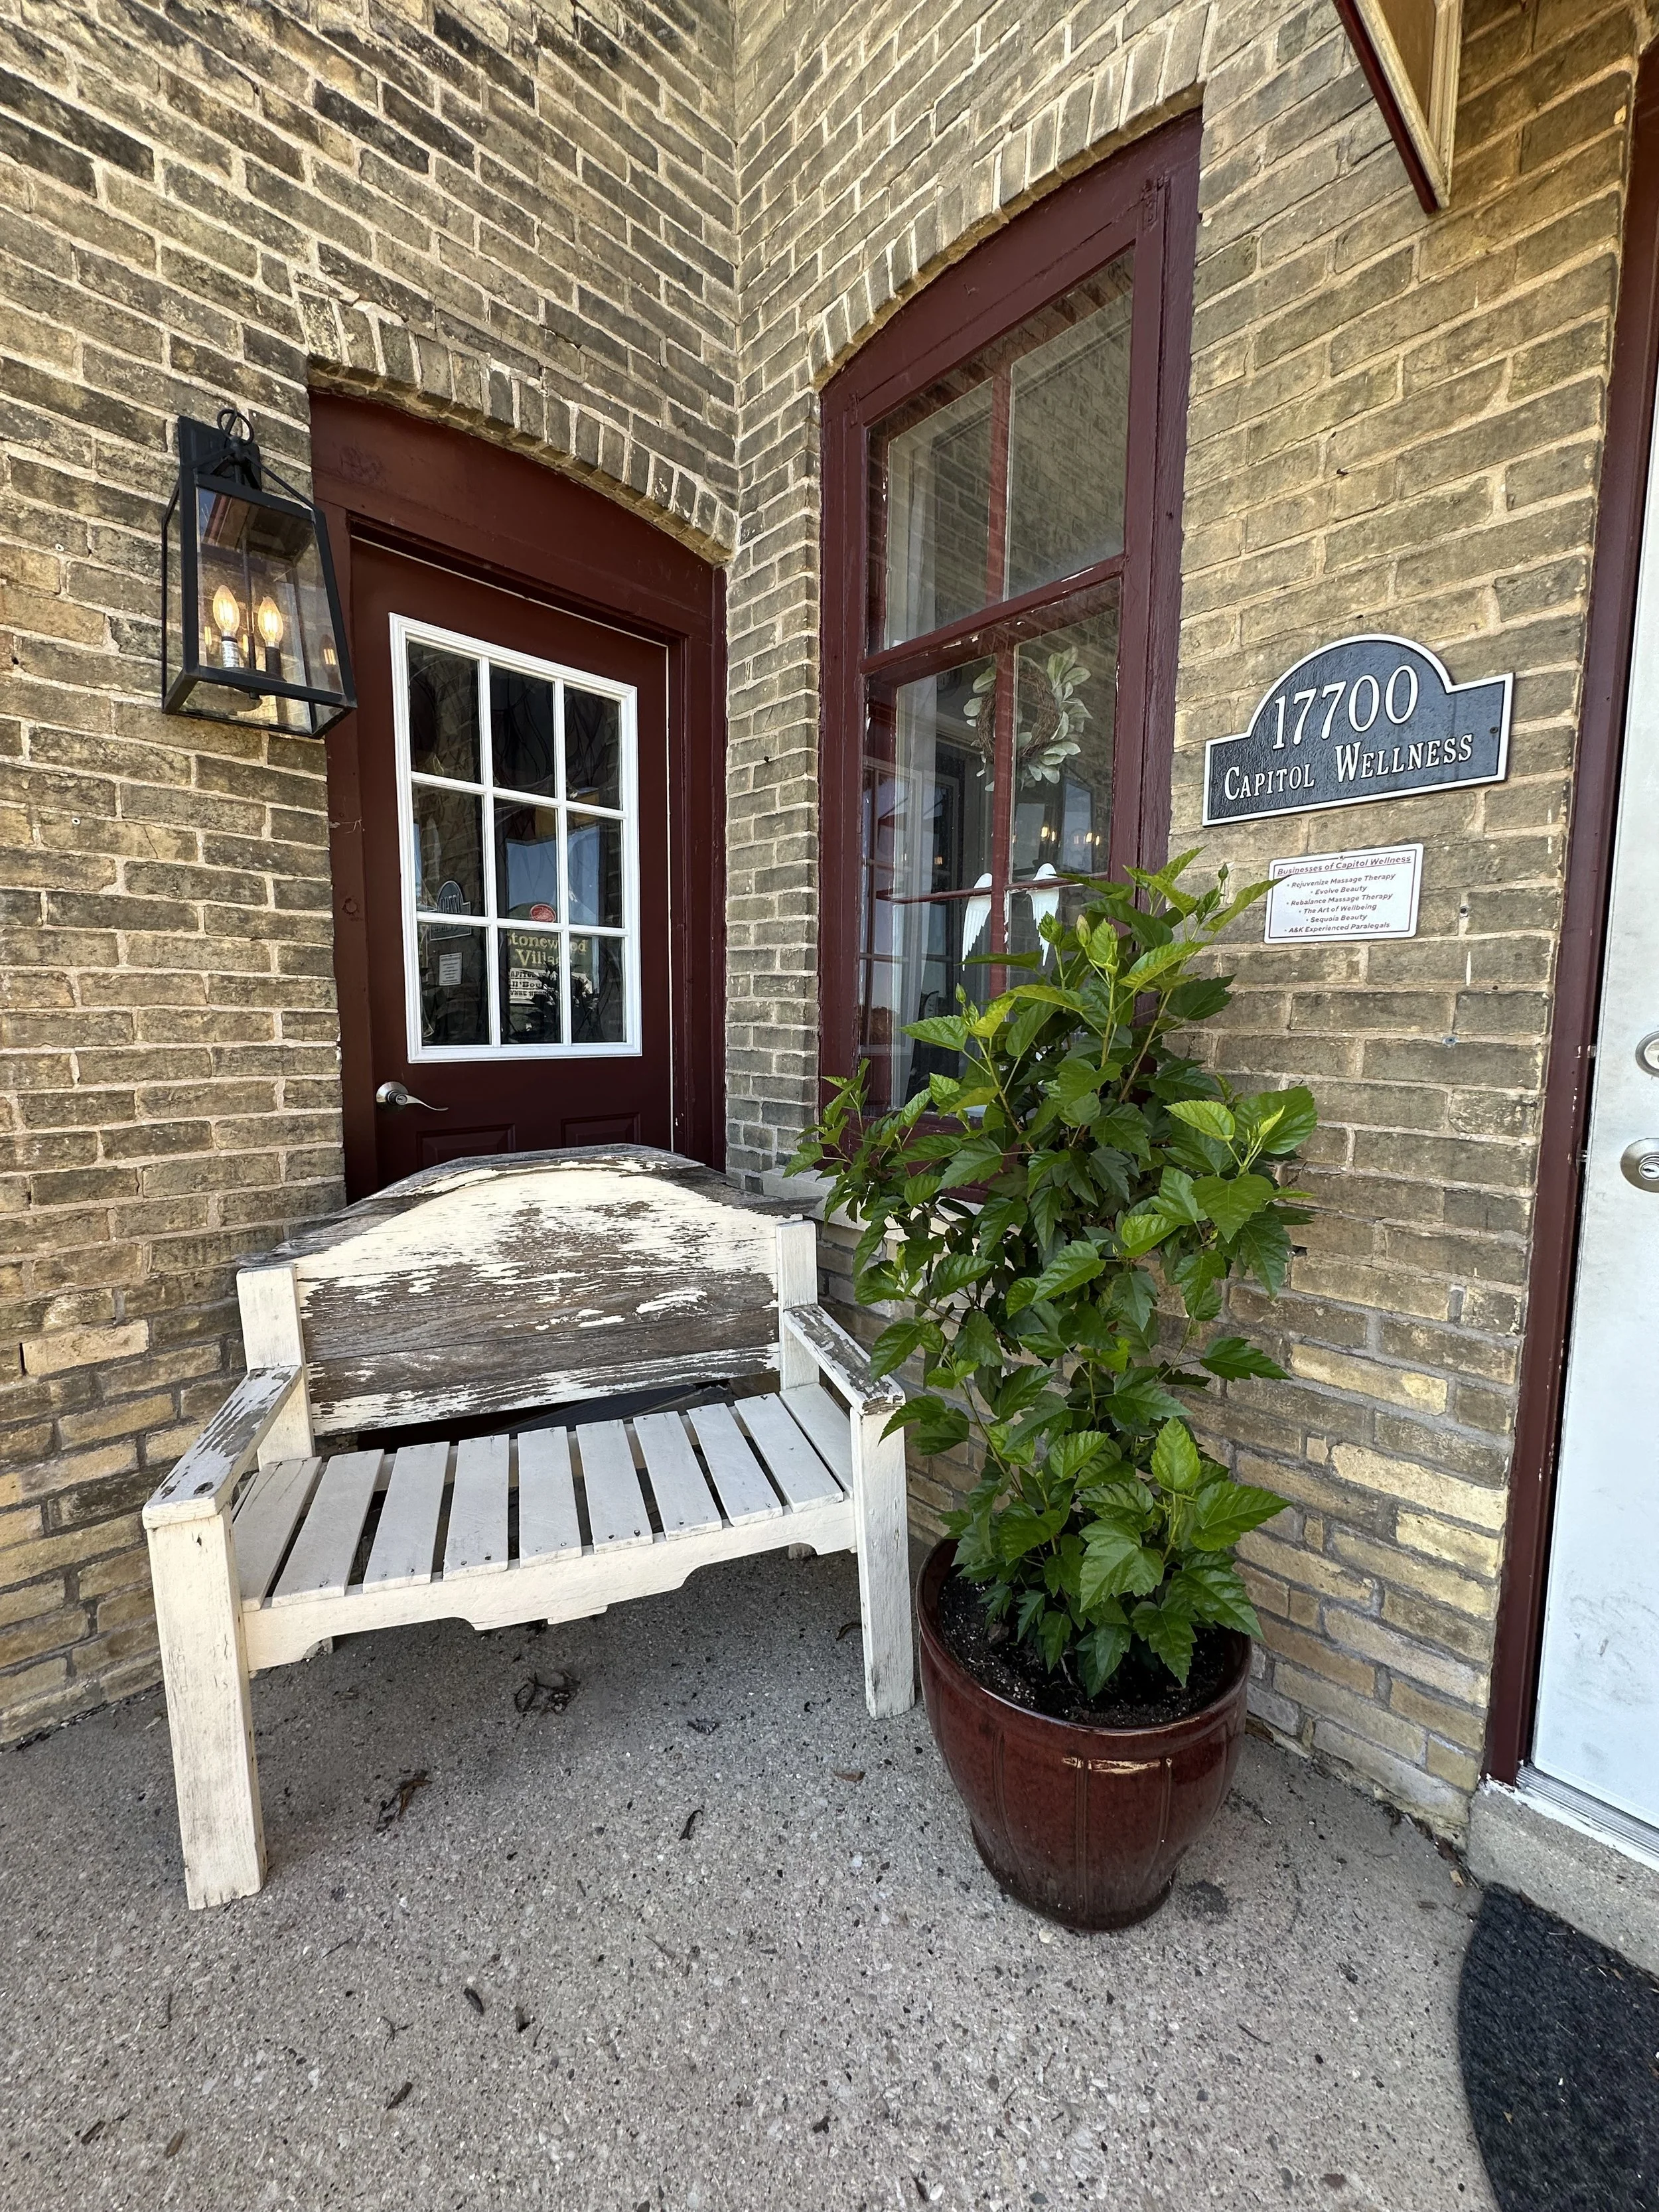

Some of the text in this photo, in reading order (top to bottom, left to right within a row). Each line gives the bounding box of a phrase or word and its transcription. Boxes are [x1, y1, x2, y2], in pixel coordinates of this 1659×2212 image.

[1272, 665, 1418, 750] 17700
[1224, 733, 1473, 800] CAPITOL WELLNESS
[1277, 866, 1323, 875] Businesses
[1336, 859, 1368, 870] Capitol
[1370, 855, 1411, 865] Wellness
[1291, 873, 1396, 889] Rejuvenize Massage Therapy
[1291, 898, 1327, 907] Rebalance
[1362, 893, 1394, 901] Therapy
[1340, 903, 1377, 912] Wellbeing
[1305, 924, 1349, 933] Experienced
[1350, 922, 1390, 930] Paralegals
[508, 932, 587, 952] tonewod
